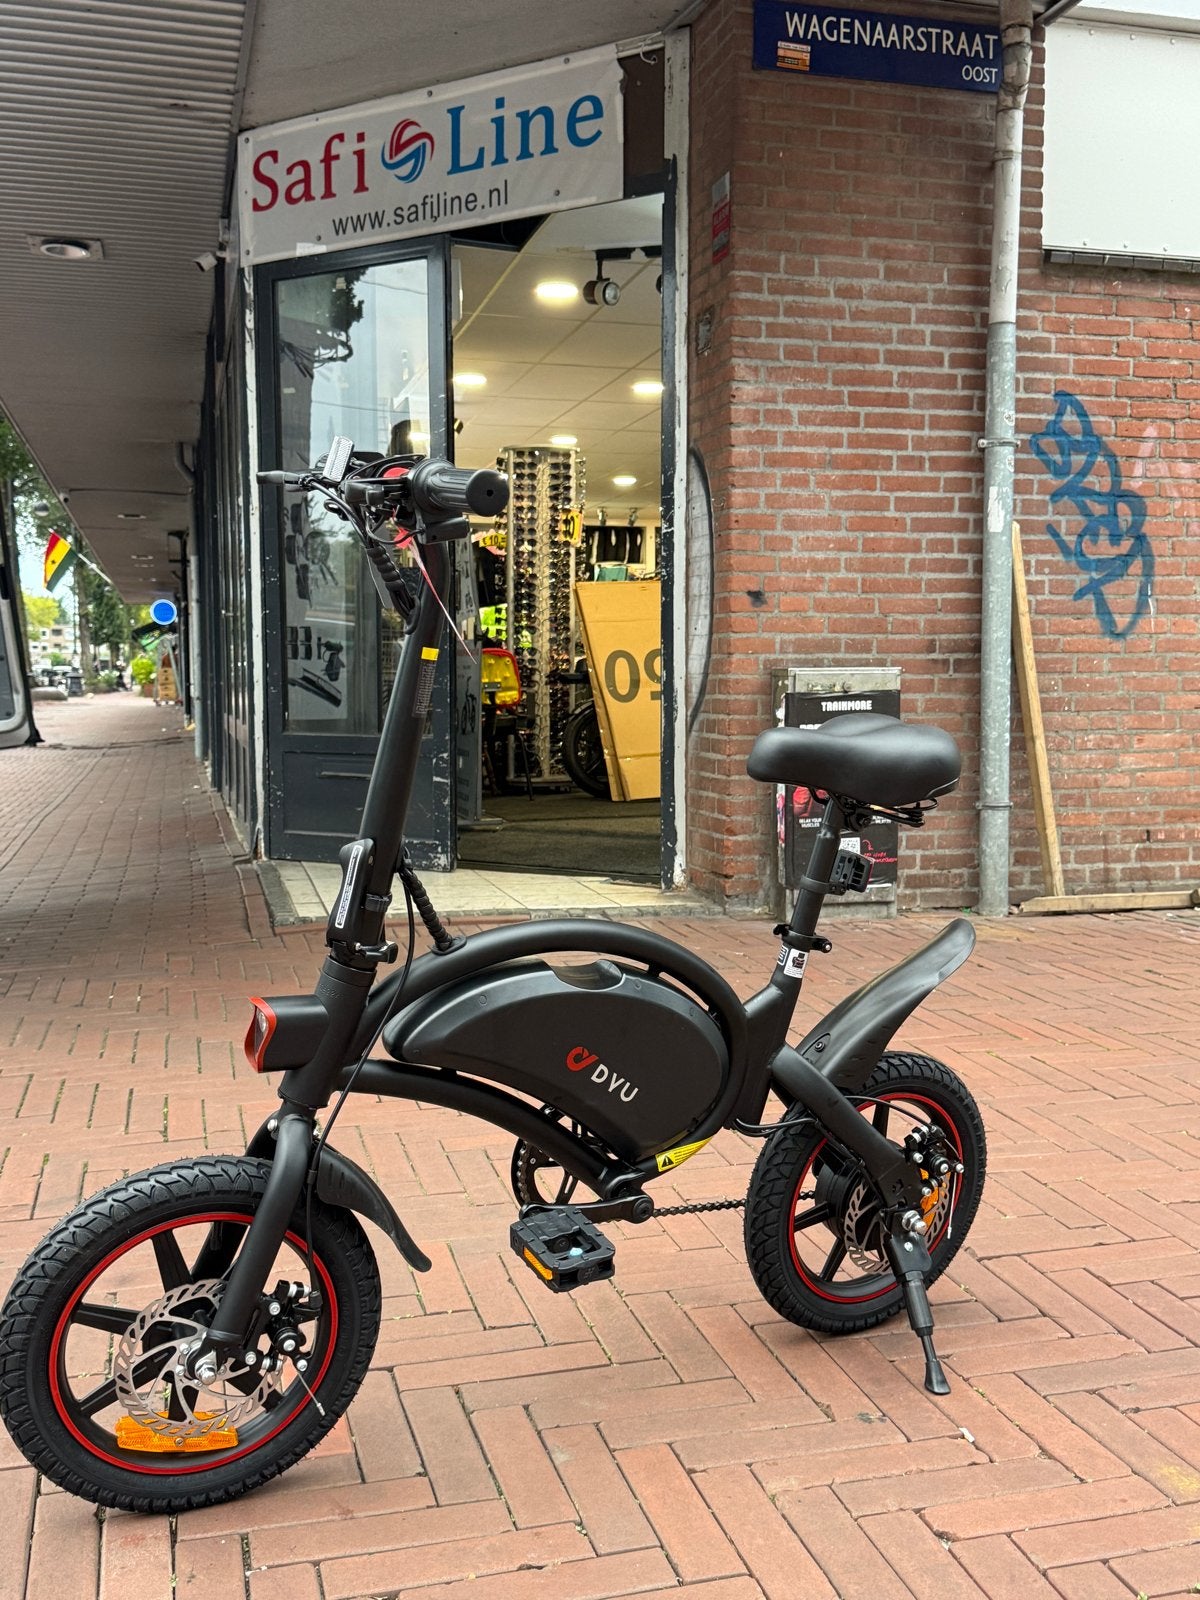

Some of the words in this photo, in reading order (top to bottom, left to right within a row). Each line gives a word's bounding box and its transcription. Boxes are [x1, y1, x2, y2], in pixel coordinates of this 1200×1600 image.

[785, 11, 998, 60] WAGENAARSTRAAT
[962, 64, 998, 84] OOST
[252, 132, 370, 212] Safi
[446, 94, 604, 176] Line
[332, 179, 508, 236] www.safiline.nl
[590, 1063, 639, 1102] DYU
